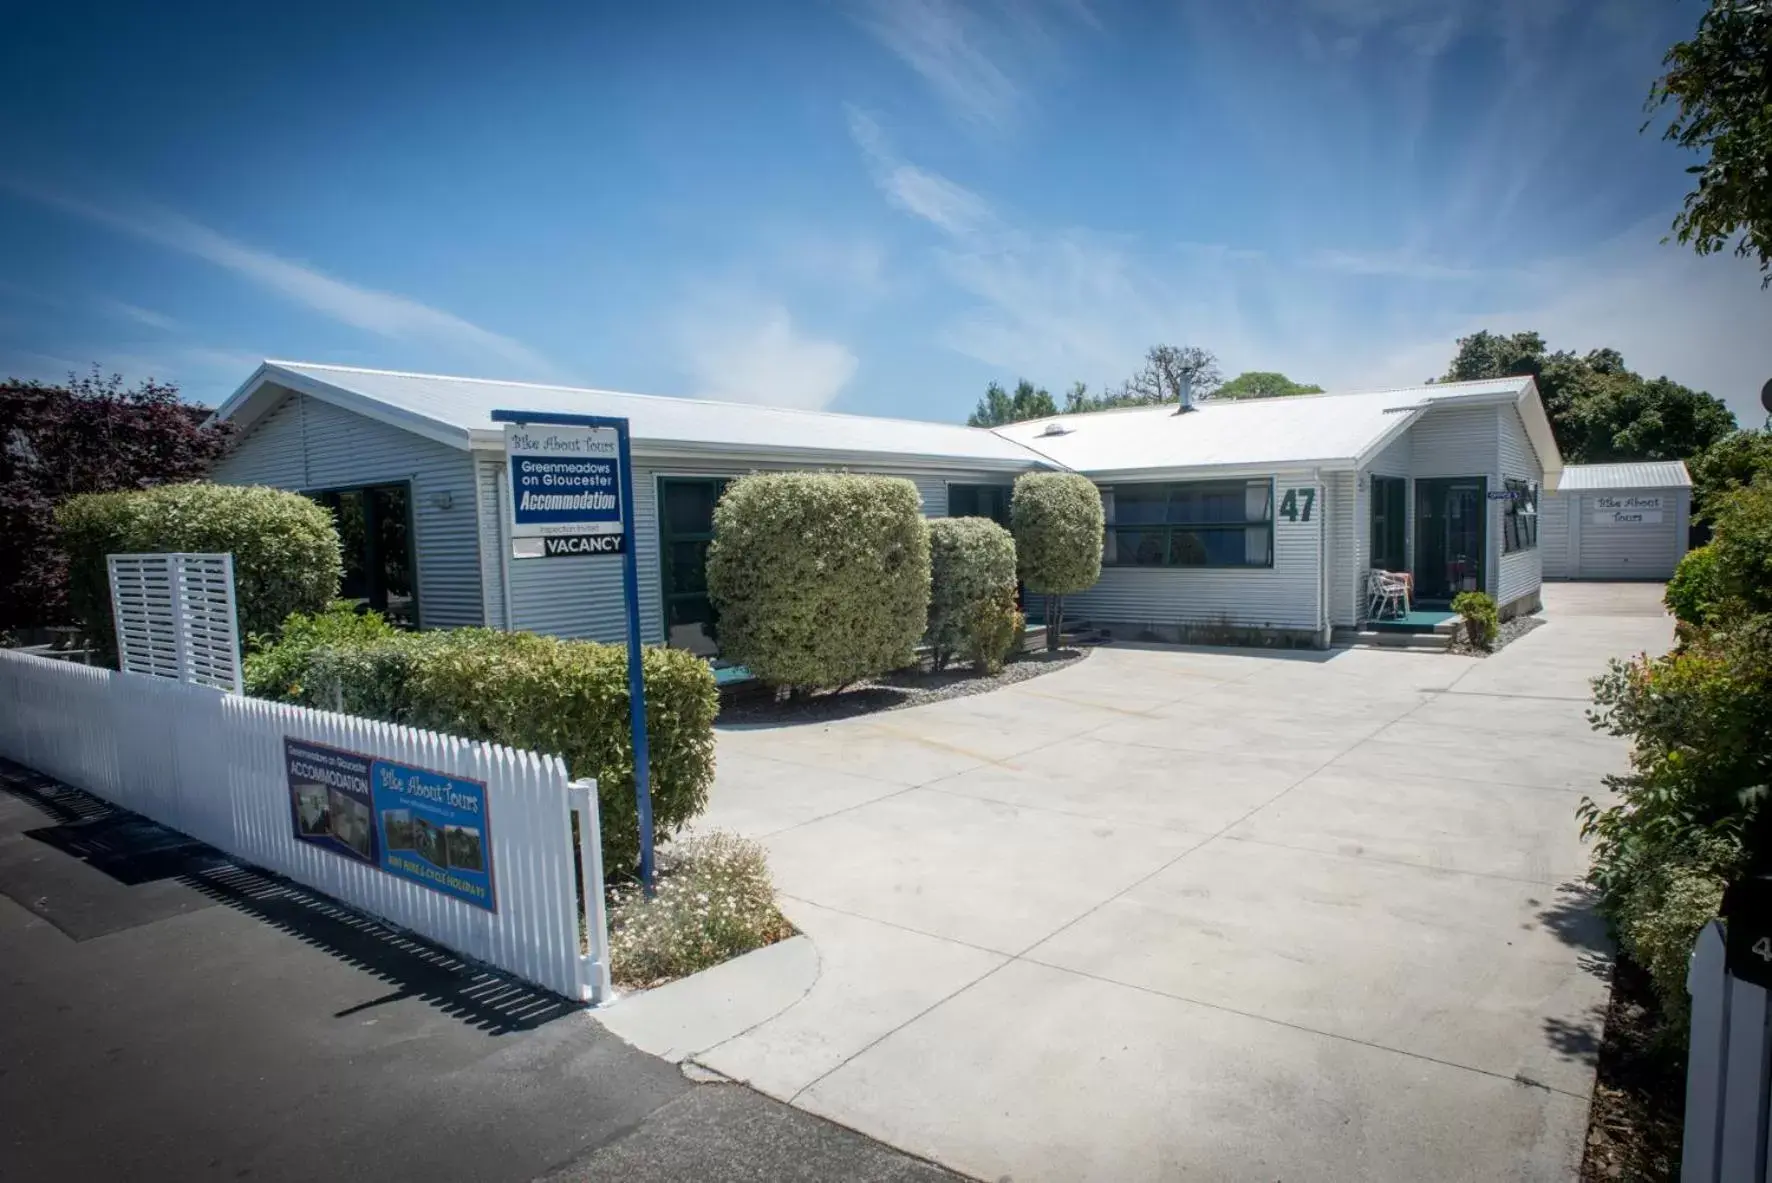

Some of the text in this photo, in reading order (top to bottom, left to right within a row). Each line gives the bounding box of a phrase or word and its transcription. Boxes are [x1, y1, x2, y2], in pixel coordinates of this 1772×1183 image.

[511, 433, 616, 453] Bike About Tours
[521, 461, 610, 474] Greenmeadows
[522, 474, 612, 486] on Gloucester
[520, 490, 616, 511] Accommodation
[1280, 487, 1315, 522] 47
[546, 536, 621, 553] VACANCY
[290, 760, 369, 795] ACCOMMODATION
[380, 767, 404, 792] Bike
[407, 775, 442, 801] About
[442, 782, 478, 814] Tours
